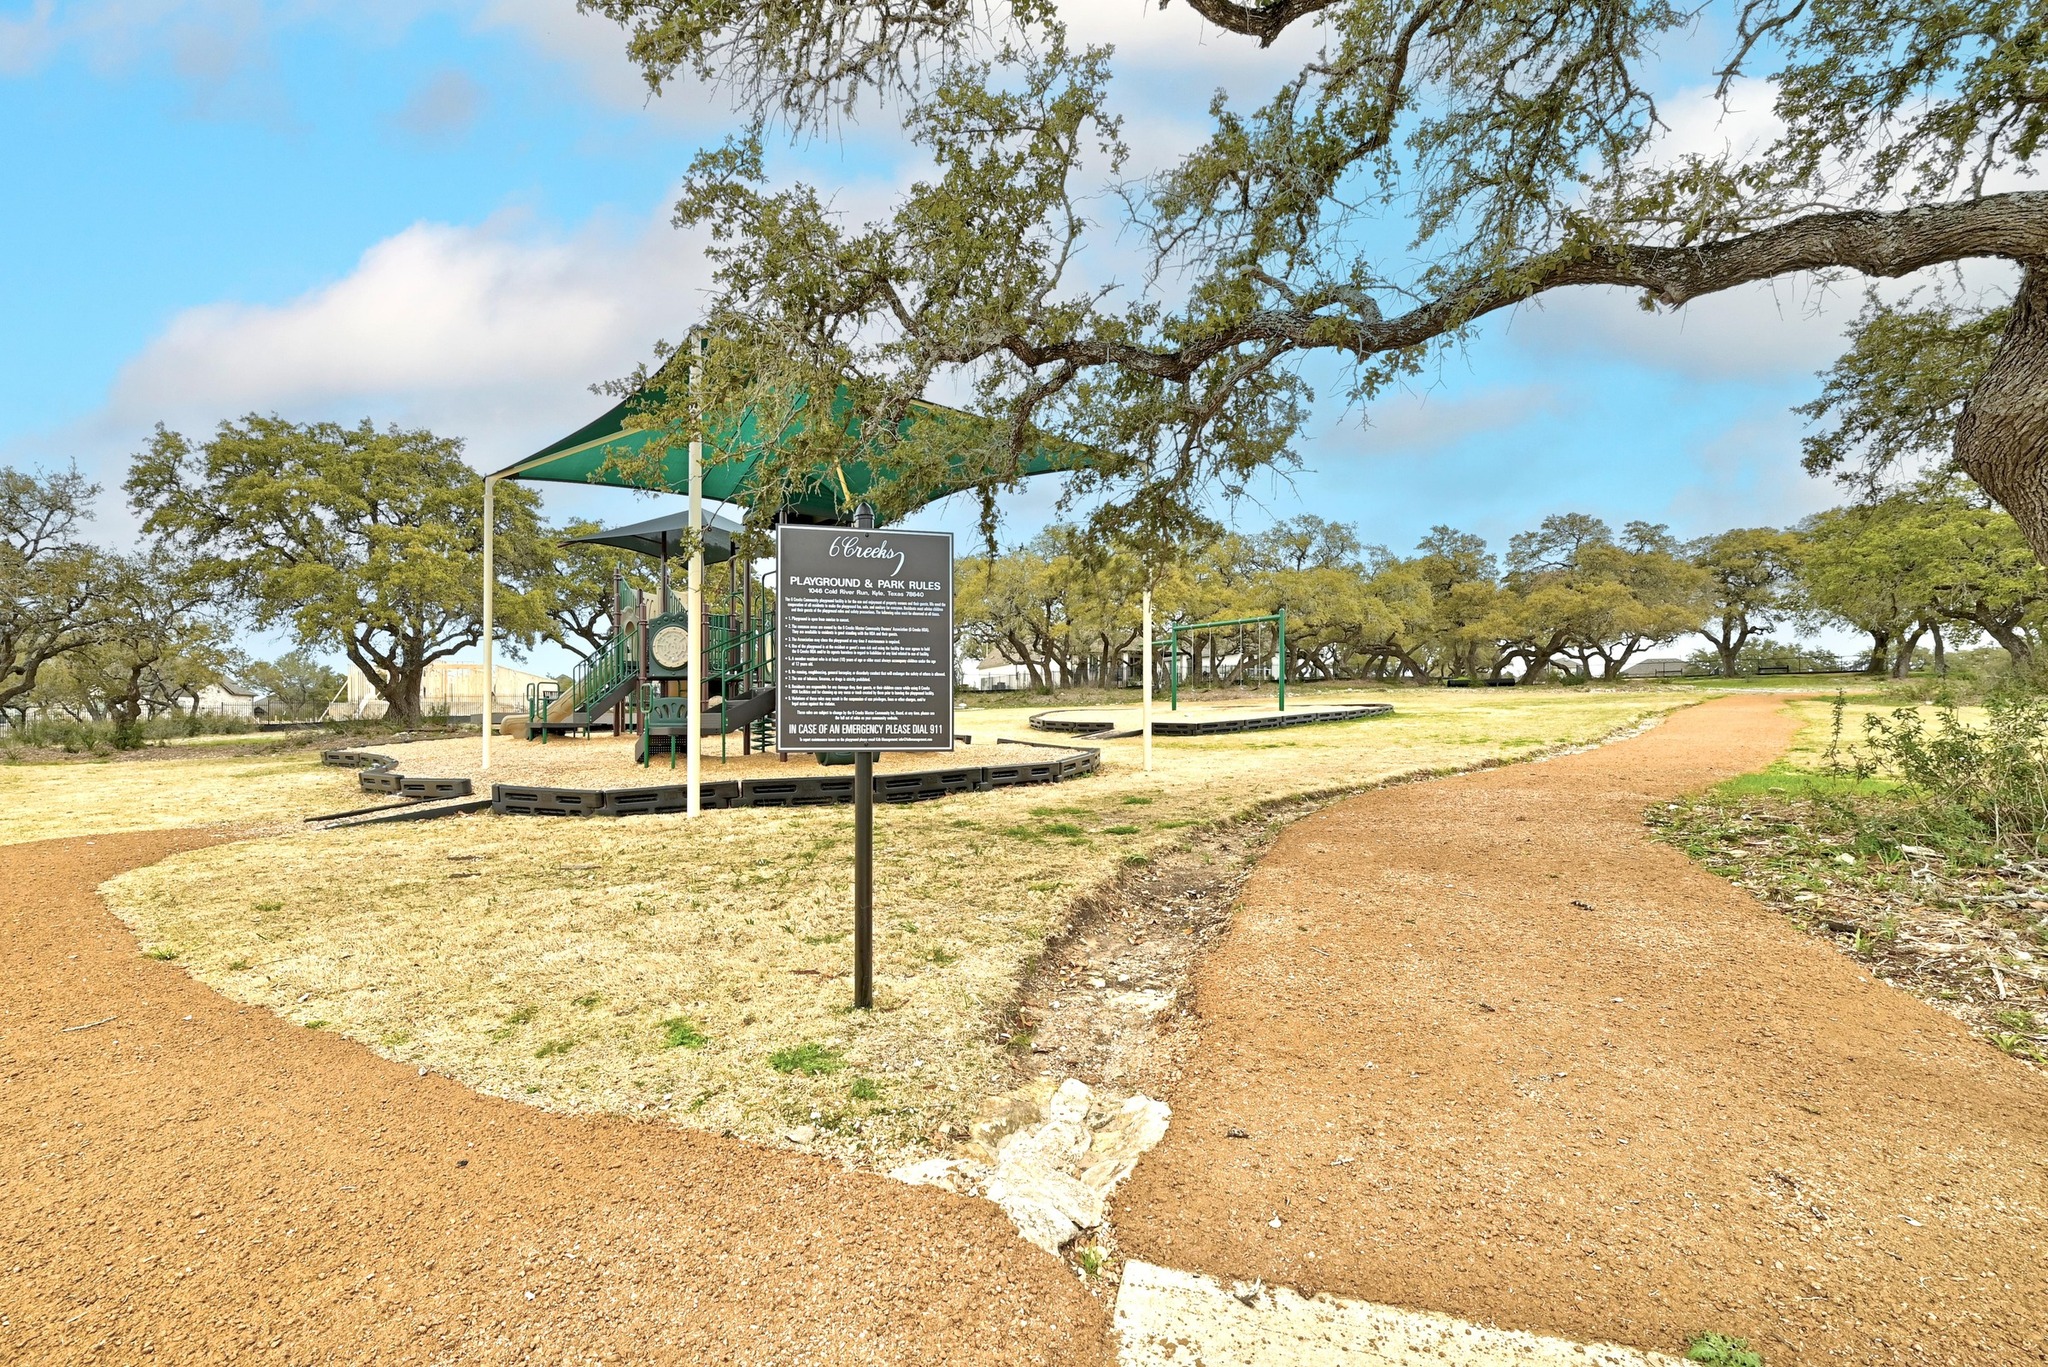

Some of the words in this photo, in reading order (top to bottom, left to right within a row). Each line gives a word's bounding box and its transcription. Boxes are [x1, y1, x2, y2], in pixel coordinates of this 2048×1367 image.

[829, 536, 841, 556] 6
[842, 536, 905, 577] Creeks
[790, 576, 860, 588] PLAYGROUND
[864, 579, 873, 588] &
[878, 580, 905, 590] PARK
[909, 581, 941, 591] RULES
[789, 724, 796, 734] IN
[798, 724, 817, 734] CASE
[819, 724, 828, 734] OF
[829, 724, 840, 734] AN
[842, 724, 883, 734] EMERGENCY
[886, 724, 911, 734] PLEASE
[912, 724, 928, 734] DIAL
[930, 724, 942, 734] 911
